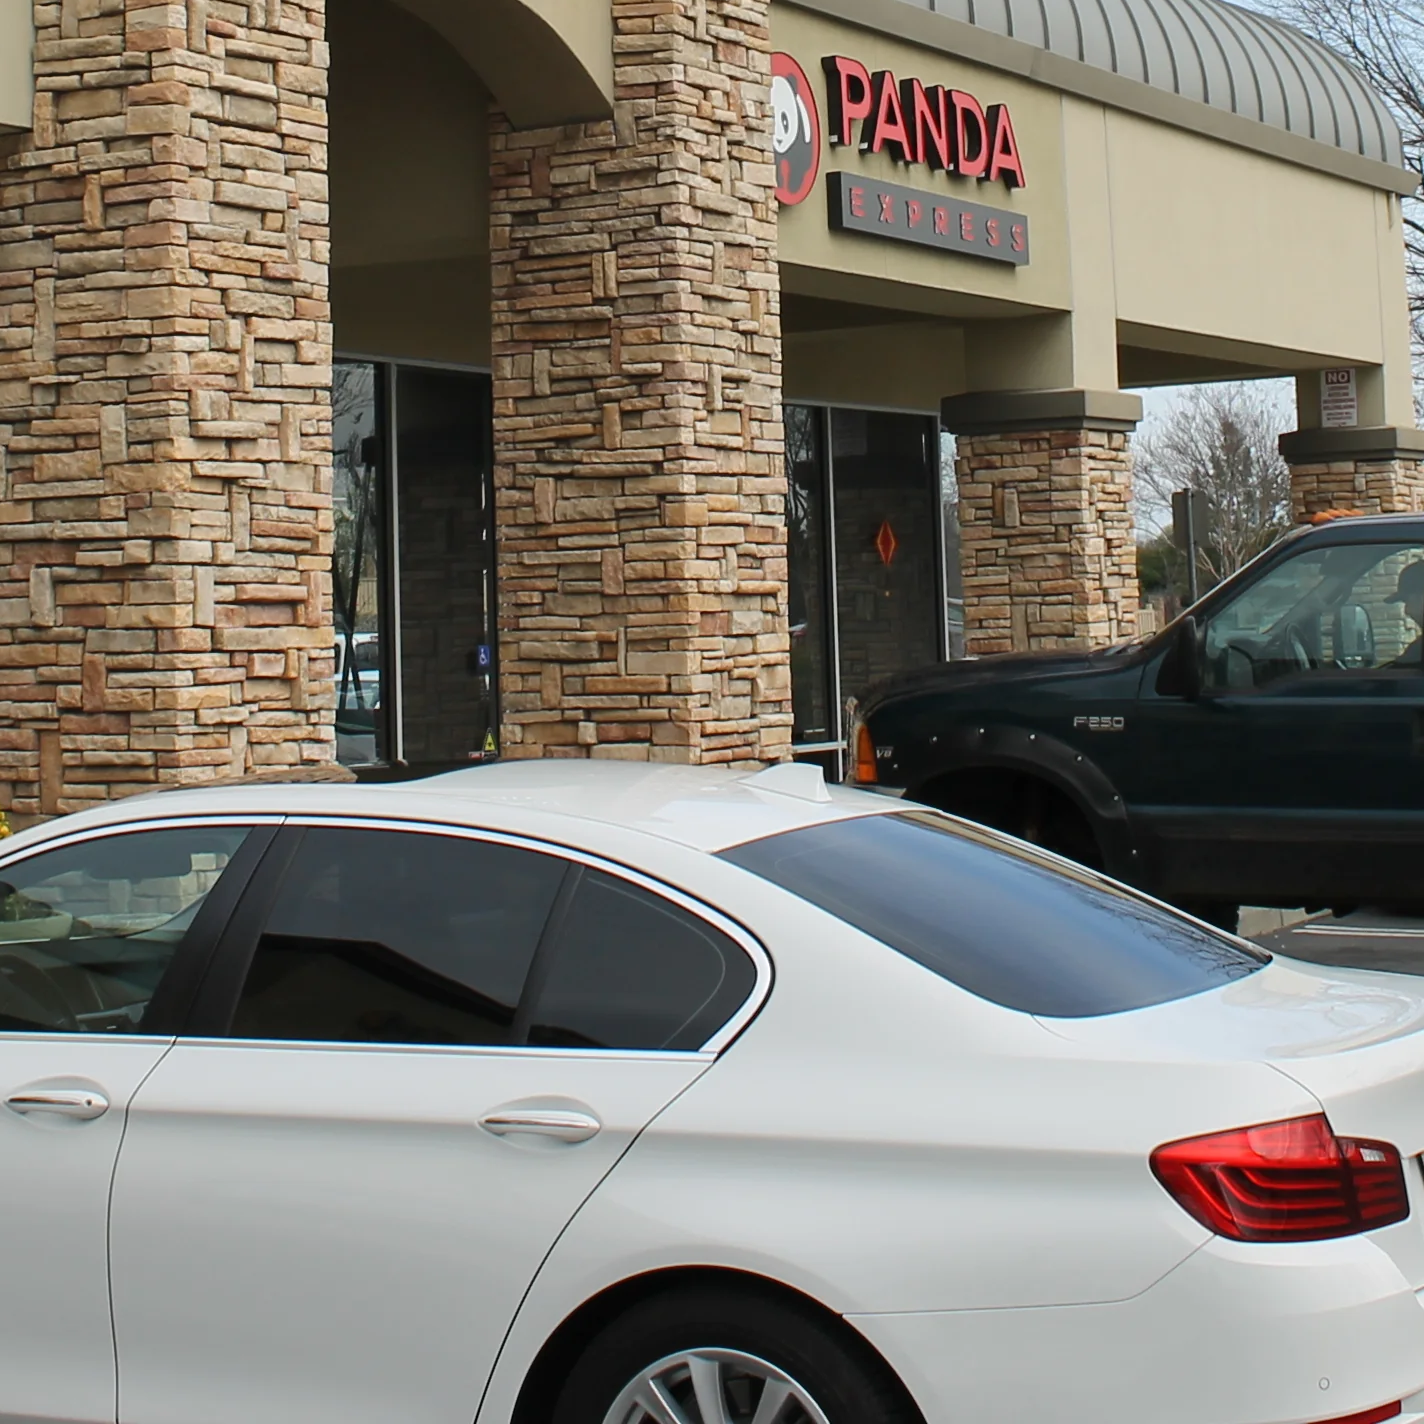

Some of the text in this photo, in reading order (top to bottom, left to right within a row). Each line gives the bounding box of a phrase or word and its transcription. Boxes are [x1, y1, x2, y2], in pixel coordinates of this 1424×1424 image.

[830, 55, 1026, 189] PANDA
[849, 187, 1025, 253] EXPRESS
[1327, 372, 1349, 383] NO
